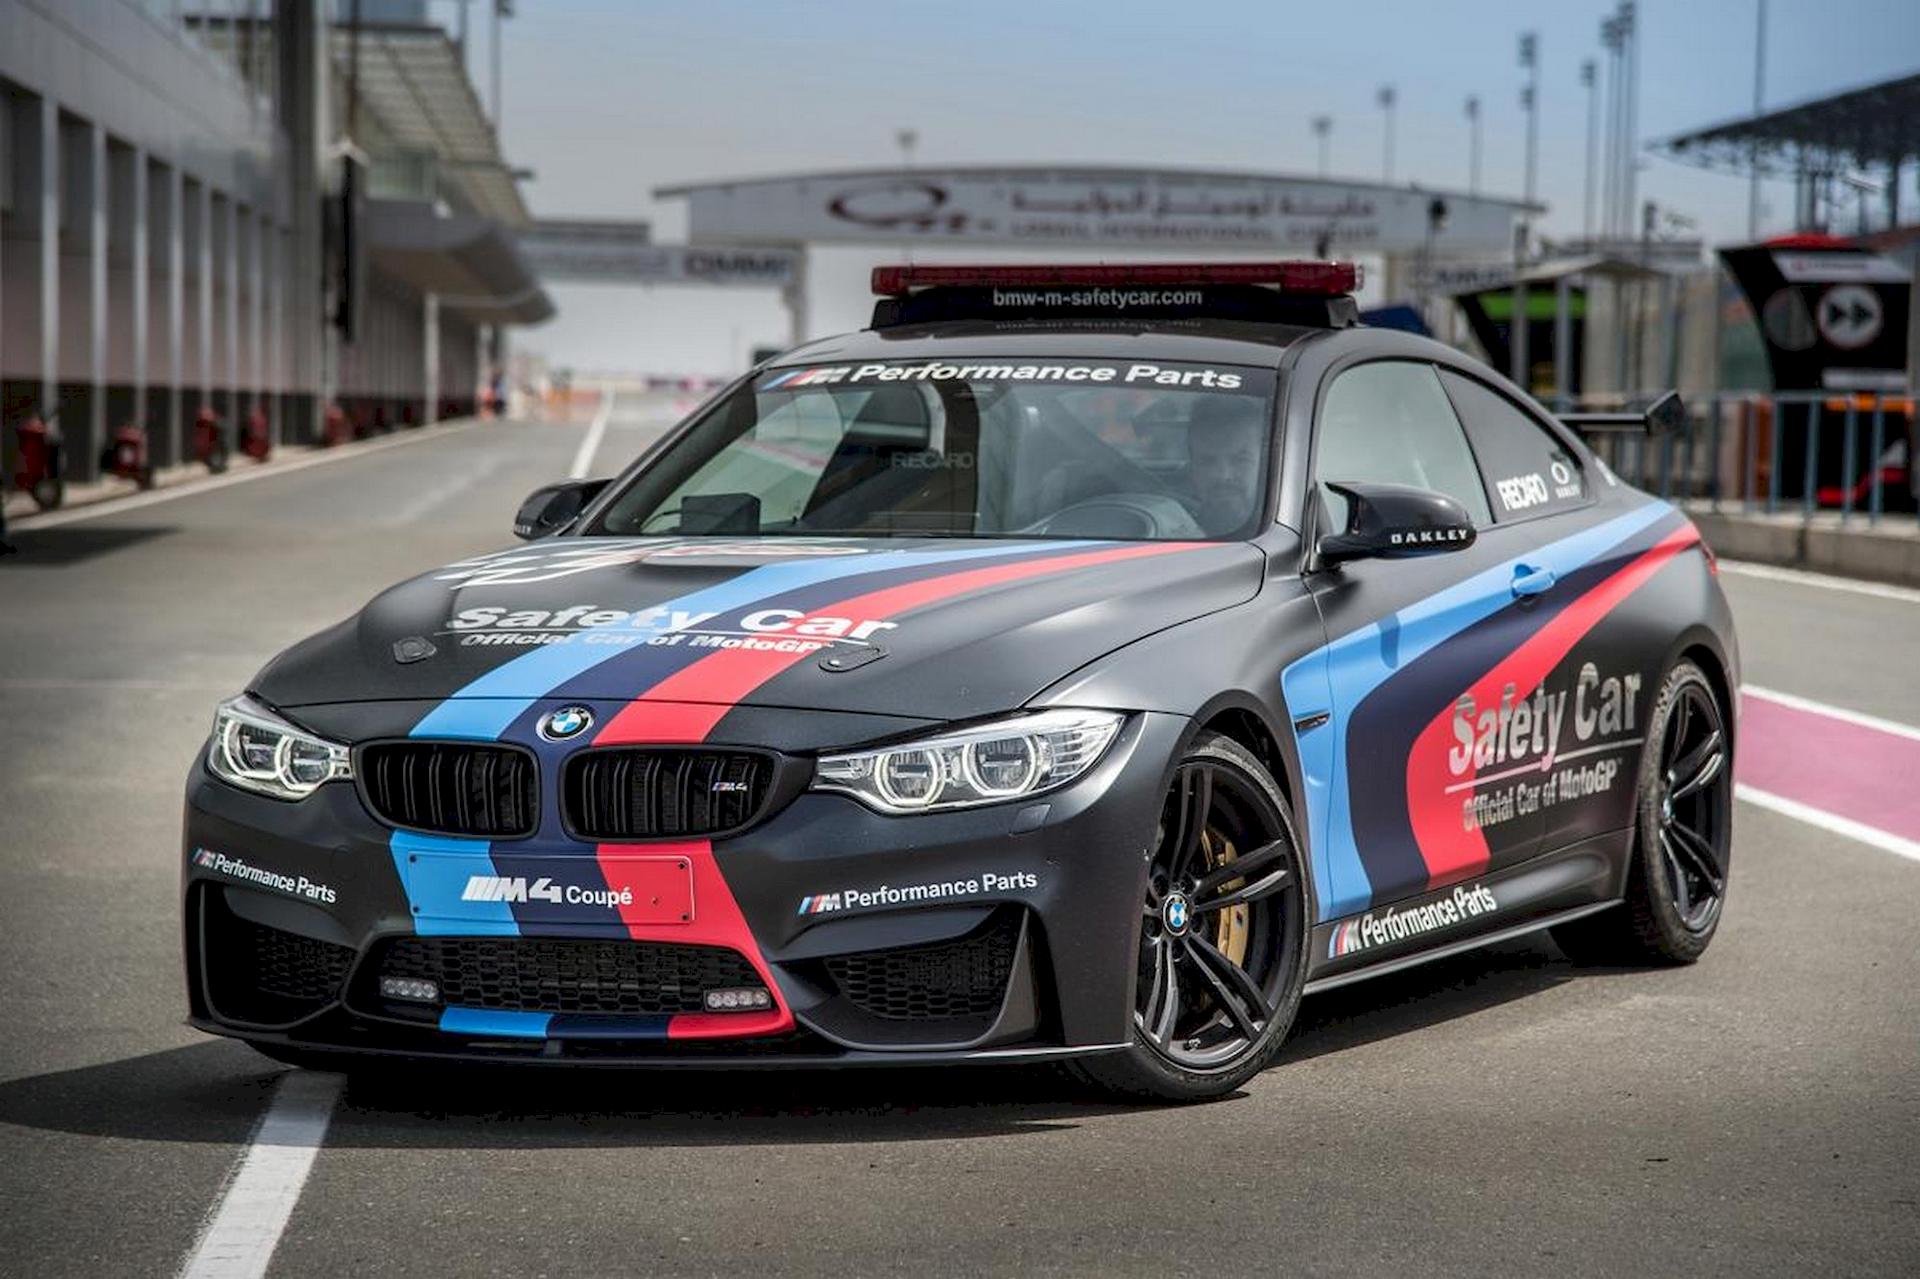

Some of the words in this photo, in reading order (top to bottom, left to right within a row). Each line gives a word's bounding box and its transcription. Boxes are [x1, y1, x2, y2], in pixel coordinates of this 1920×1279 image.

[992, 287, 1203, 309] bmw-m-safetycar.com
[851, 363, 1117, 382] Performance
[1125, 365, 1242, 388] Parts
[1496, 473, 1549, 511] RECARO
[1391, 529, 1468, 545] OAKLEY
[446, 605, 720, 634] Safety
[740, 609, 899, 639] Car
[460, 631, 576, 647] Official
[587, 633, 639, 647] Car
[647, 634, 687, 647] of
[1449, 679, 1567, 776] Safety
[1575, 662, 1642, 741] Car
[1463, 785, 1514, 832] Official
[1517, 783, 1540, 815] Car
[1543, 774, 1558, 807] of
[214, 852, 295, 892] Performance
[296, 876, 337, 903] Parts
[844, 877, 978, 908] Performance
[982, 871, 1038, 892] Parts
[566, 886, 633, 908] Coupé
[1361, 898, 1459, 948] Performance
[1453, 884, 1498, 919] Parts
